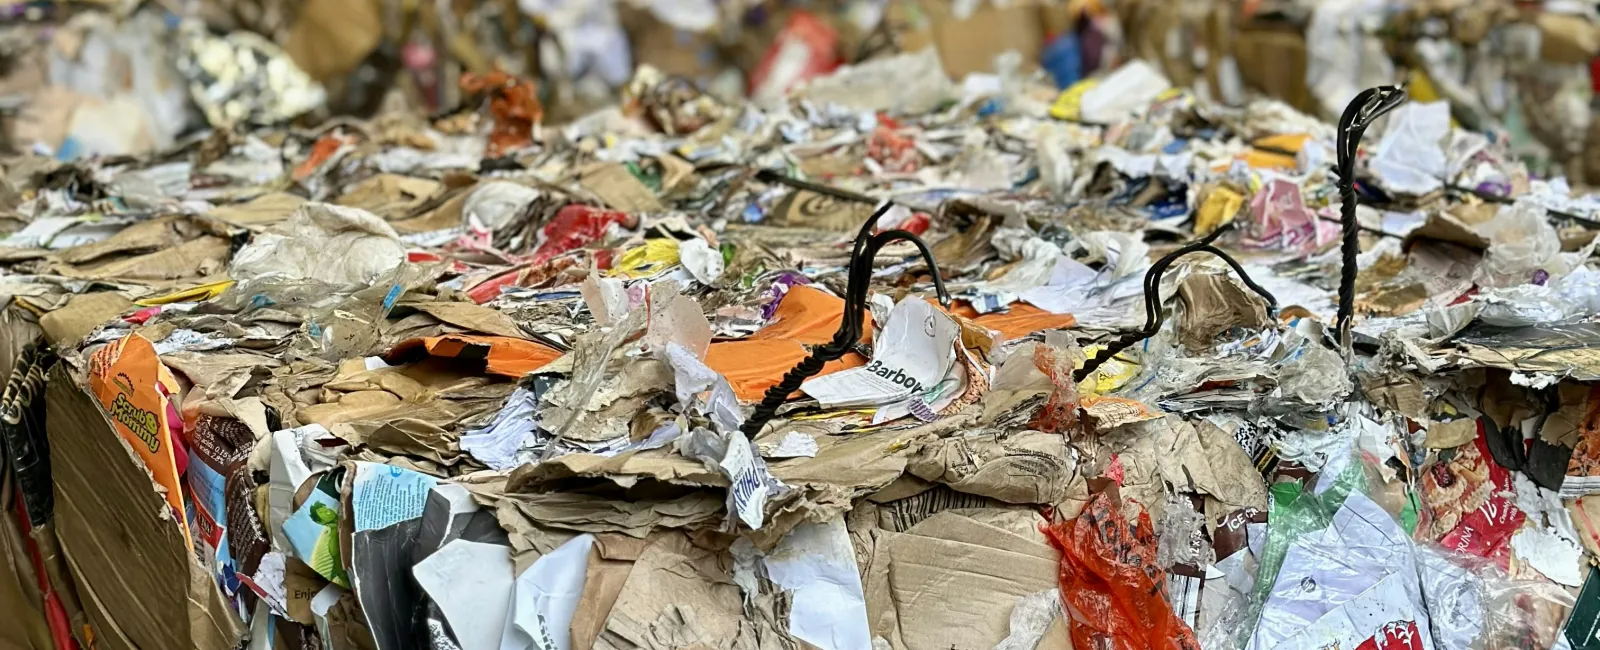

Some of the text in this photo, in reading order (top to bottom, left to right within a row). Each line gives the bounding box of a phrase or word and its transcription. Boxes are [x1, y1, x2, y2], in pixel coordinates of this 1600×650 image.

[116, 392, 147, 426] Scrub
[110, 400, 160, 453] Mommy
[1226, 513, 1246, 533] ICE
